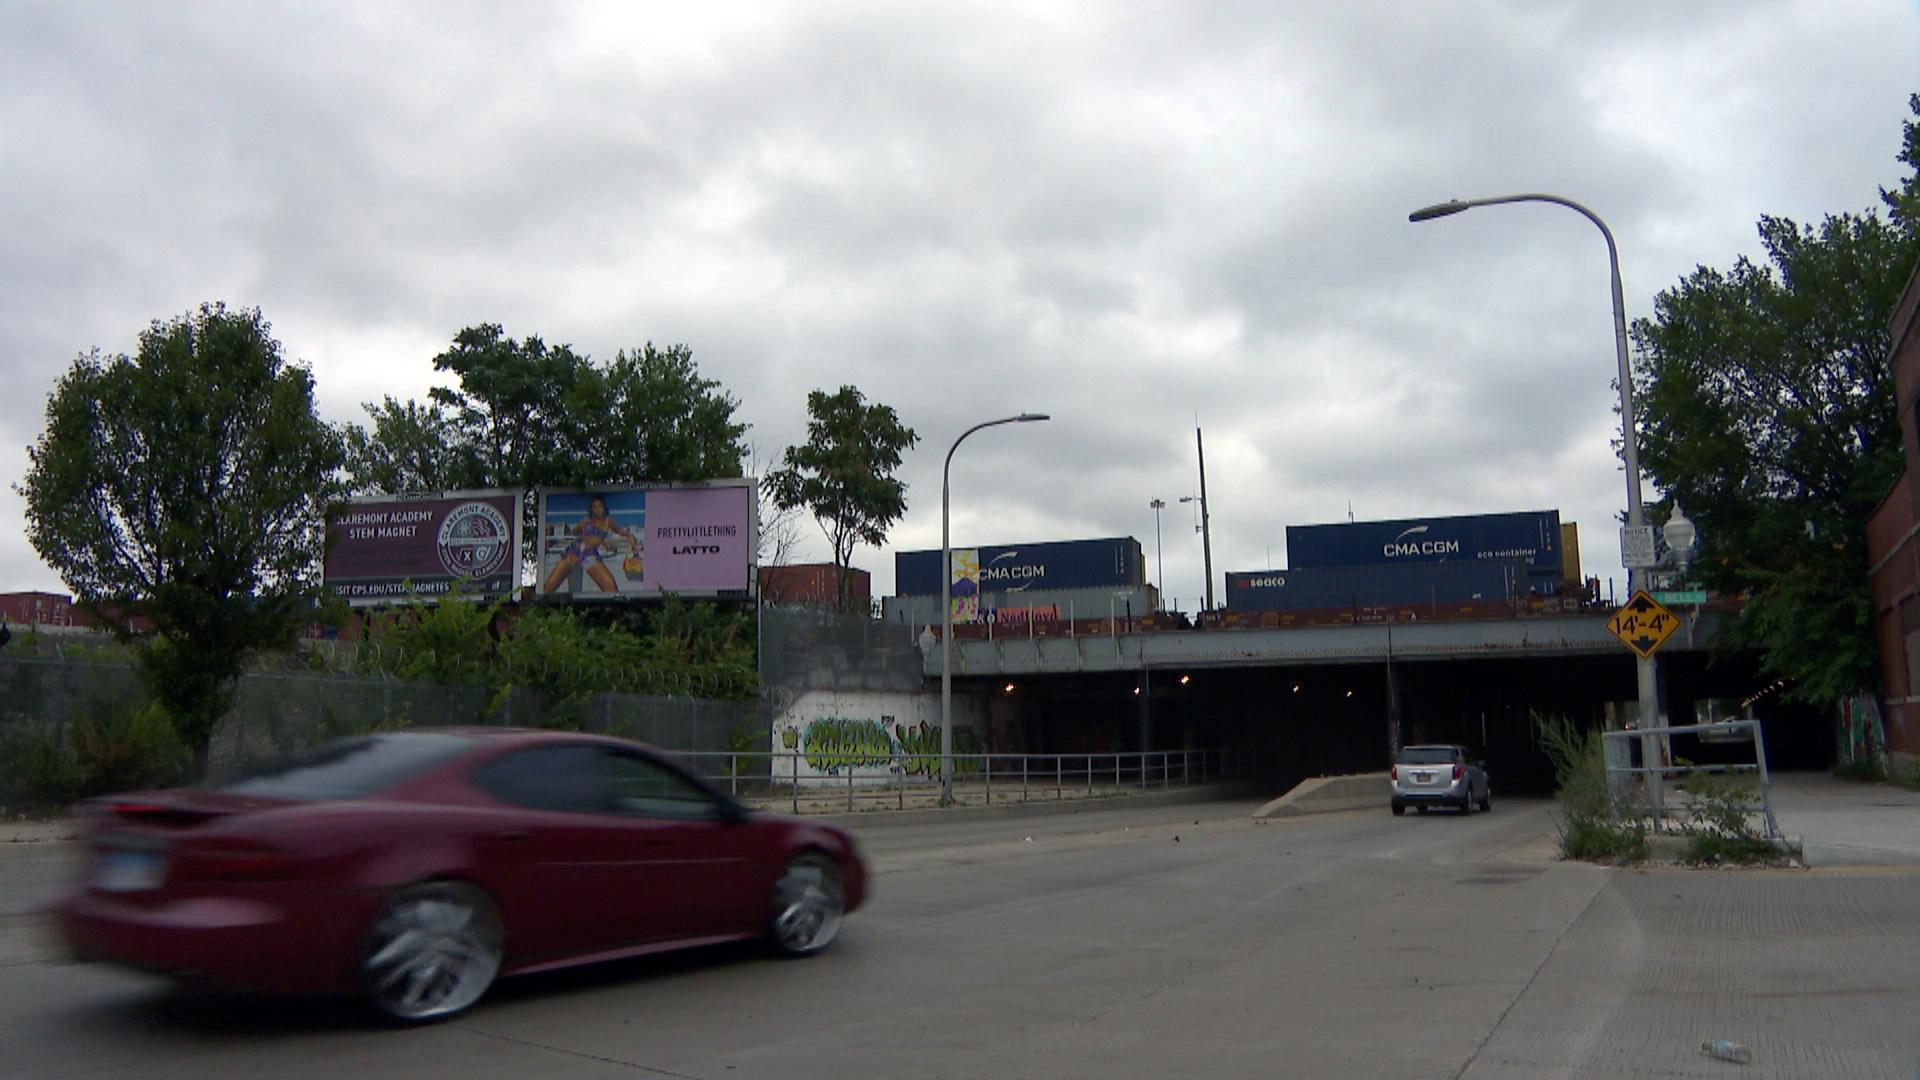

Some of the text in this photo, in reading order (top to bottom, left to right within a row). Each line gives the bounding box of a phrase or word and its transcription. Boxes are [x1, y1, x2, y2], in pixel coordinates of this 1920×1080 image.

[336, 510, 433, 525] LAREMONT ACADEMY
[349, 525, 418, 540] STEM MAGNET
[657, 525, 736, 538] PRETTYLITTLETHING
[672, 545, 720, 555] LATTO
[1383, 540, 1460, 557] CMA CGM
[978, 565, 1045, 581] CMA CGM
[1250, 576, 1286, 588] seaco
[335, 585, 351, 596] ISIT
